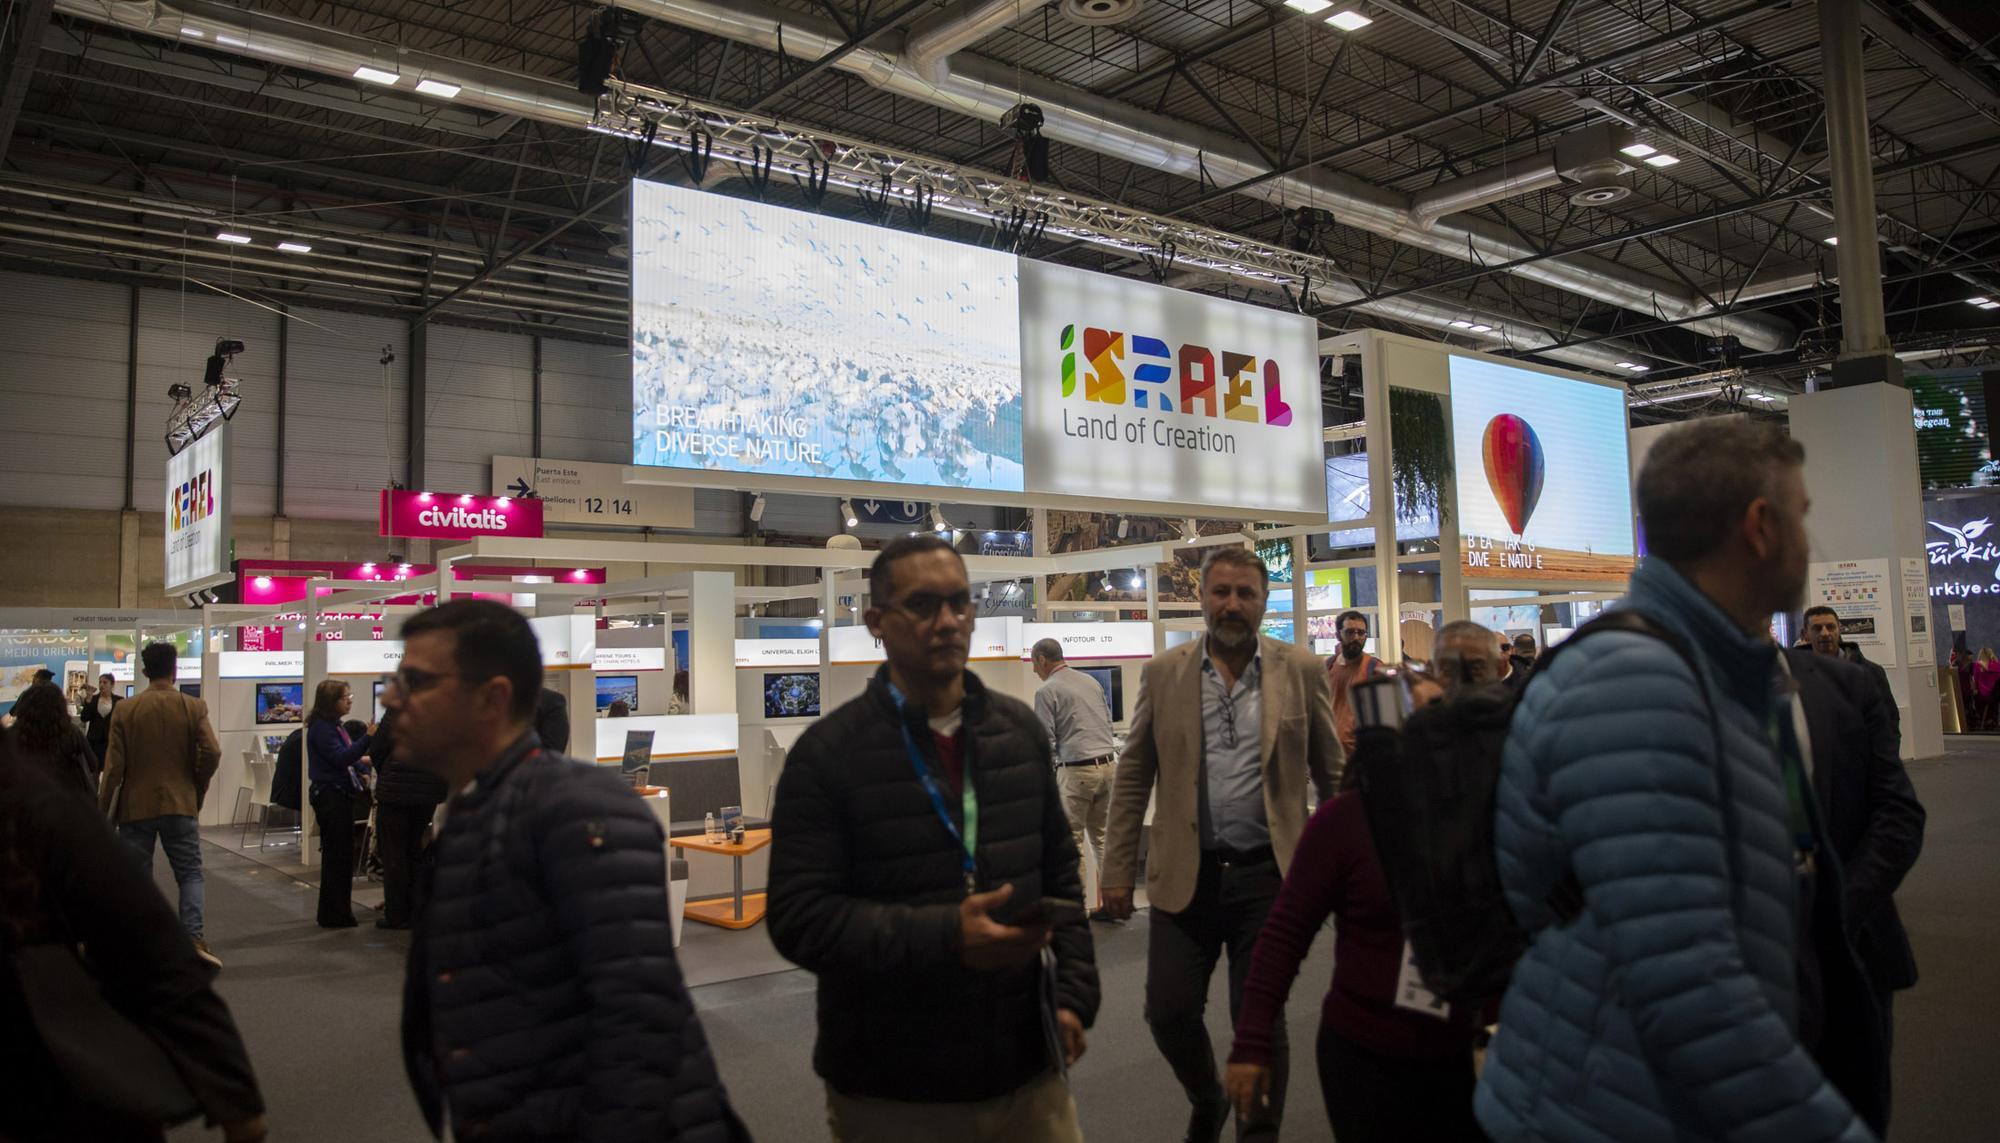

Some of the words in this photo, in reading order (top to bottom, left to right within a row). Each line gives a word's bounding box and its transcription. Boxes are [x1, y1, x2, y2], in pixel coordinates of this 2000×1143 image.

[656, 404, 807, 438] BREATHTAKING
[1063, 408, 1117, 441] Land
[1125, 417, 1146, 444] of
[1153, 420, 1236, 454] Creation
[656, 430, 740, 458] DIVERSE
[746, 438, 822, 464] NATURE
[536, 466, 561, 475] Puerta
[585, 498, 603, 513] 12
[612, 500, 632, 515] 14
[418, 505, 508, 530] civitatis
[1507, 553, 1543, 569] NATUE
[1062, 635, 1096, 643] INFOTOUR
[5, 647, 40, 657] MEDIO
[43, 645, 88, 657] ORIENTE
